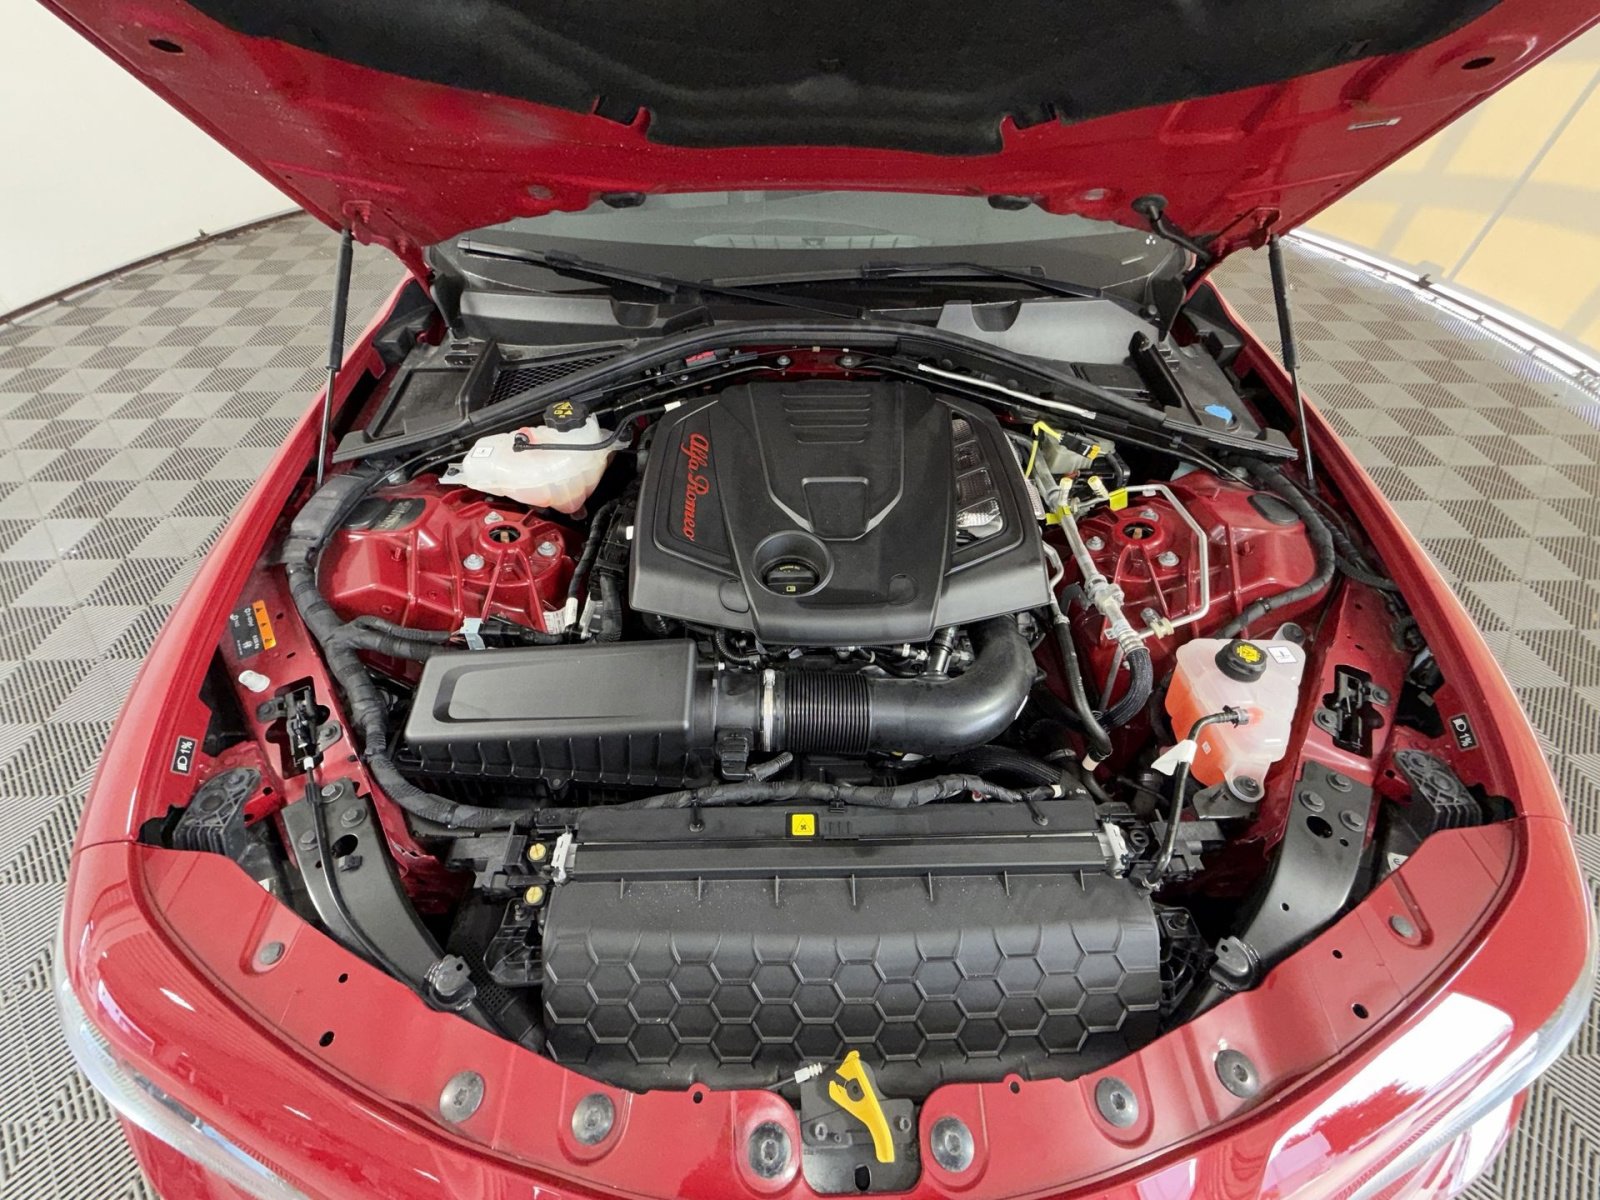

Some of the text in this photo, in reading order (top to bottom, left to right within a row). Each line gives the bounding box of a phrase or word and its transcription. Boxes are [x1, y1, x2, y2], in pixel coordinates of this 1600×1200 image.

[680, 433, 709, 541] Alfa Romeo
[1459, 733, 1473, 747] 1%
[180, 741, 193, 754] 1%
